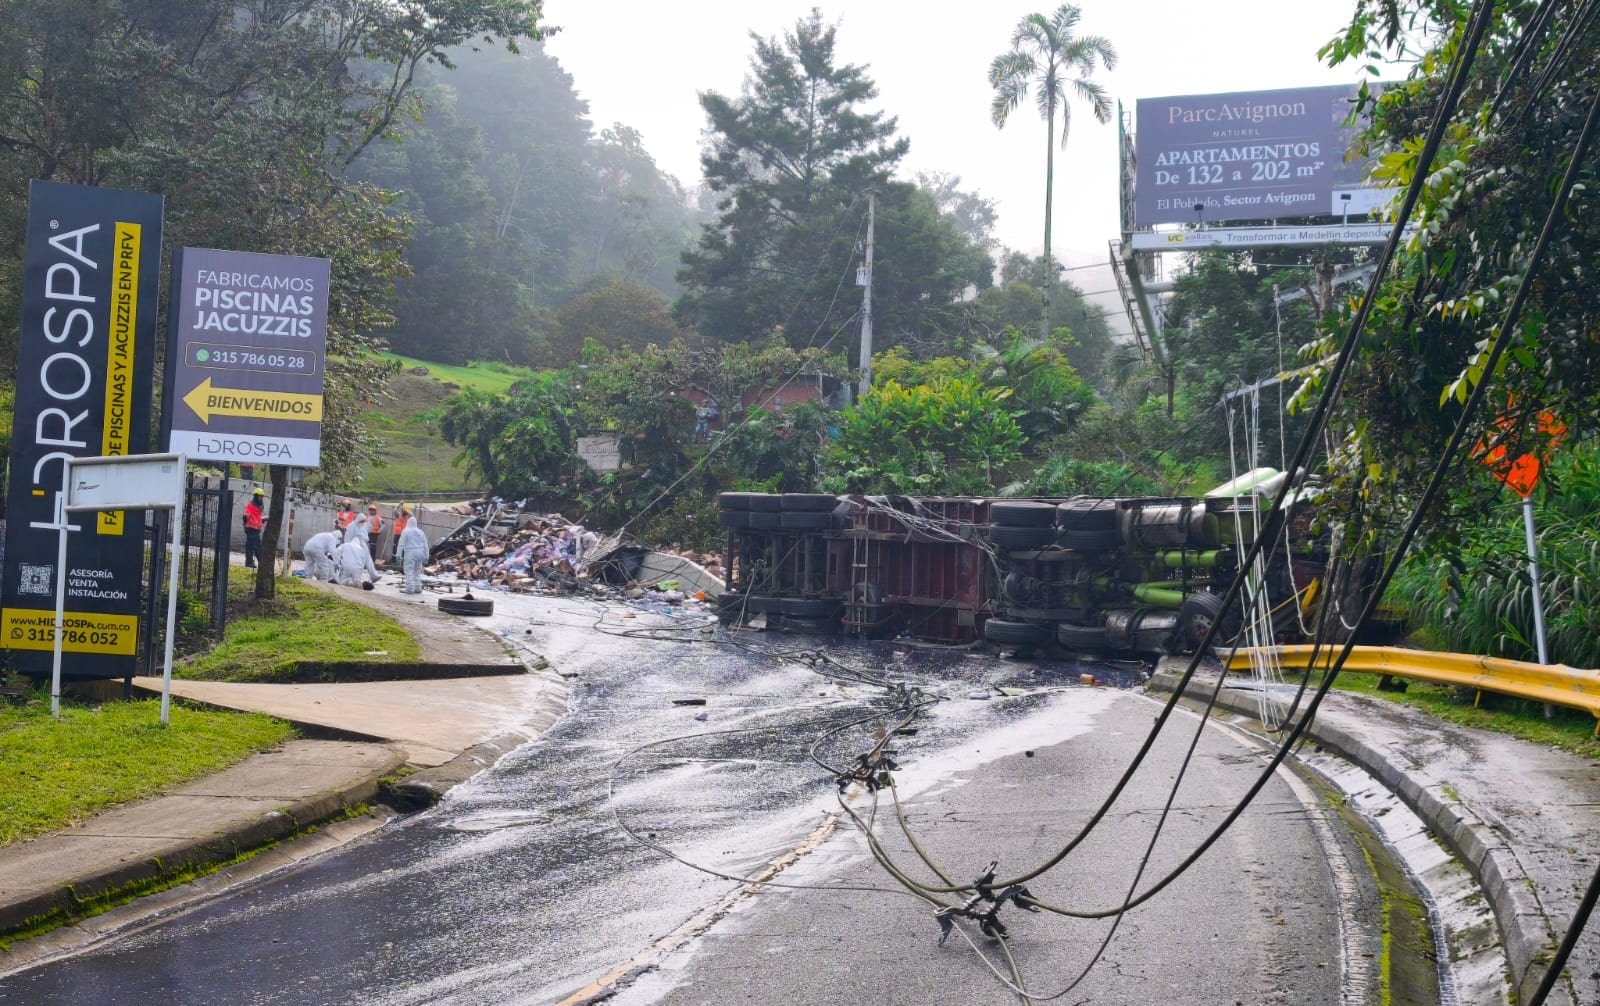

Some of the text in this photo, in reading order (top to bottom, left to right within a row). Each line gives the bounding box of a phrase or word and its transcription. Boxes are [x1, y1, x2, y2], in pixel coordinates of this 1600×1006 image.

[1168, 101, 1306, 124] ParcAvignon
[1213, 129, 1260, 137] NATUREL
[1155, 142, 1320, 166] APARTAMENTOS
[1155, 170, 1180, 185] De
[1187, 164, 1224, 185] 132
[1232, 170, 1242, 181] a
[1251, 160, 1291, 181] 202
[1157, 199, 1169, 210] El
[1223, 195, 1261, 206] Sector
[1264, 192, 1316, 206] Avignon
[1227, 231, 1288, 243] Transformar
[120, 231, 135, 269] PRFV
[119, 273, 132, 291] EN
[197, 269, 314, 292] FABRICAMOS
[195, 287, 314, 315] PISCINAS
[115, 292, 131, 360] JACUZZIS
[192, 310, 312, 338] JACUZZIS
[115, 362, 126, 371] Y
[212, 350, 305, 368] 315 786 05 28
[109, 373, 126, 437] PISCINAS
[207, 394, 312, 414] BIENVENIDOS
[69, 568, 113, 579] ASESORÍA
[68, 579, 98, 588] VENTA
[68, 588, 128, 599] INSTALACIÓN
[27, 628, 118, 646] 315 786 052
